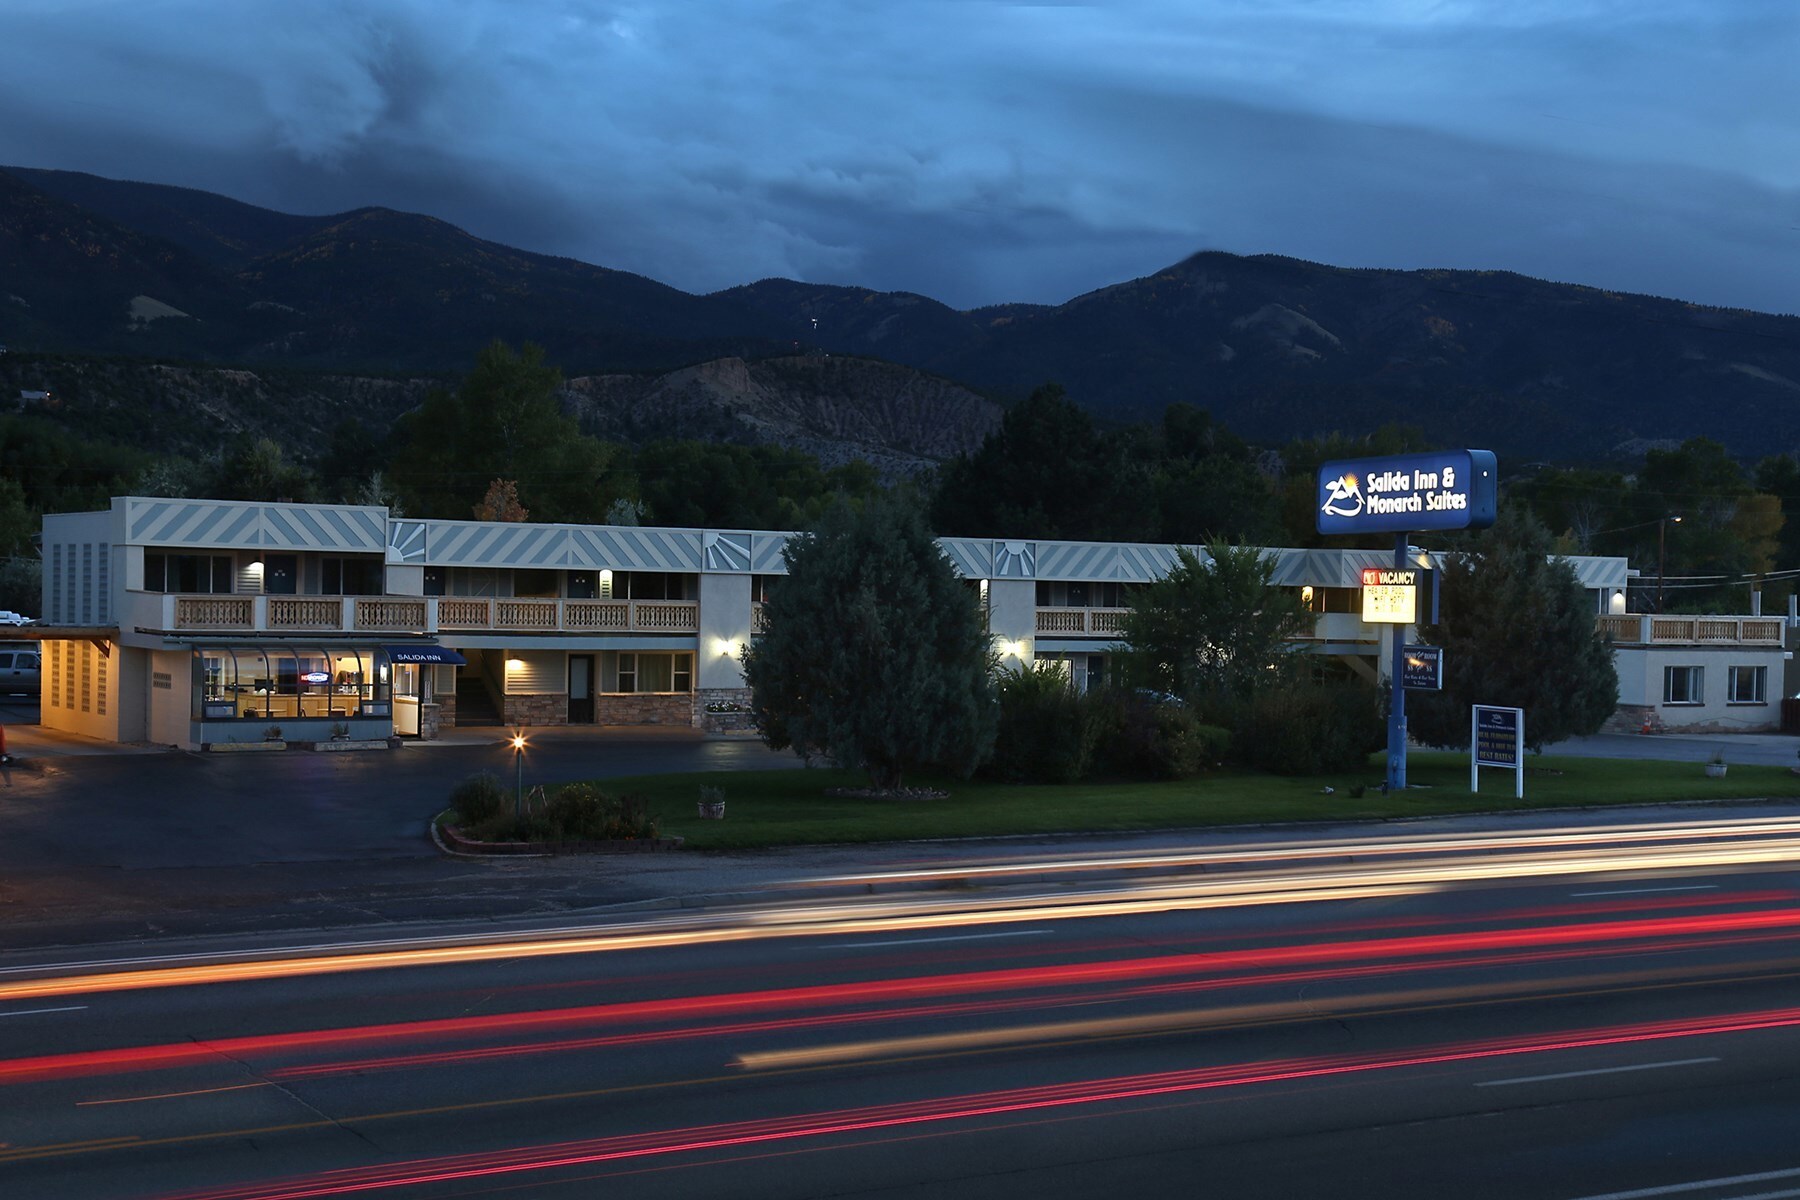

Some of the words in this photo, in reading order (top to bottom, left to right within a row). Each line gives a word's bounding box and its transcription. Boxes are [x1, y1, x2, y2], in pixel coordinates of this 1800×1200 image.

[1367, 471, 1410, 493] Salida
[1414, 470, 1437, 490] Inn
[1442, 467, 1455, 488] &
[1367, 492, 1422, 515] Monarch
[1426, 491, 1467, 511] Suites
[1363, 571, 1375, 584] NO
[1379, 571, 1415, 584] VACANCY
[397, 653, 426, 661] SALIDA
